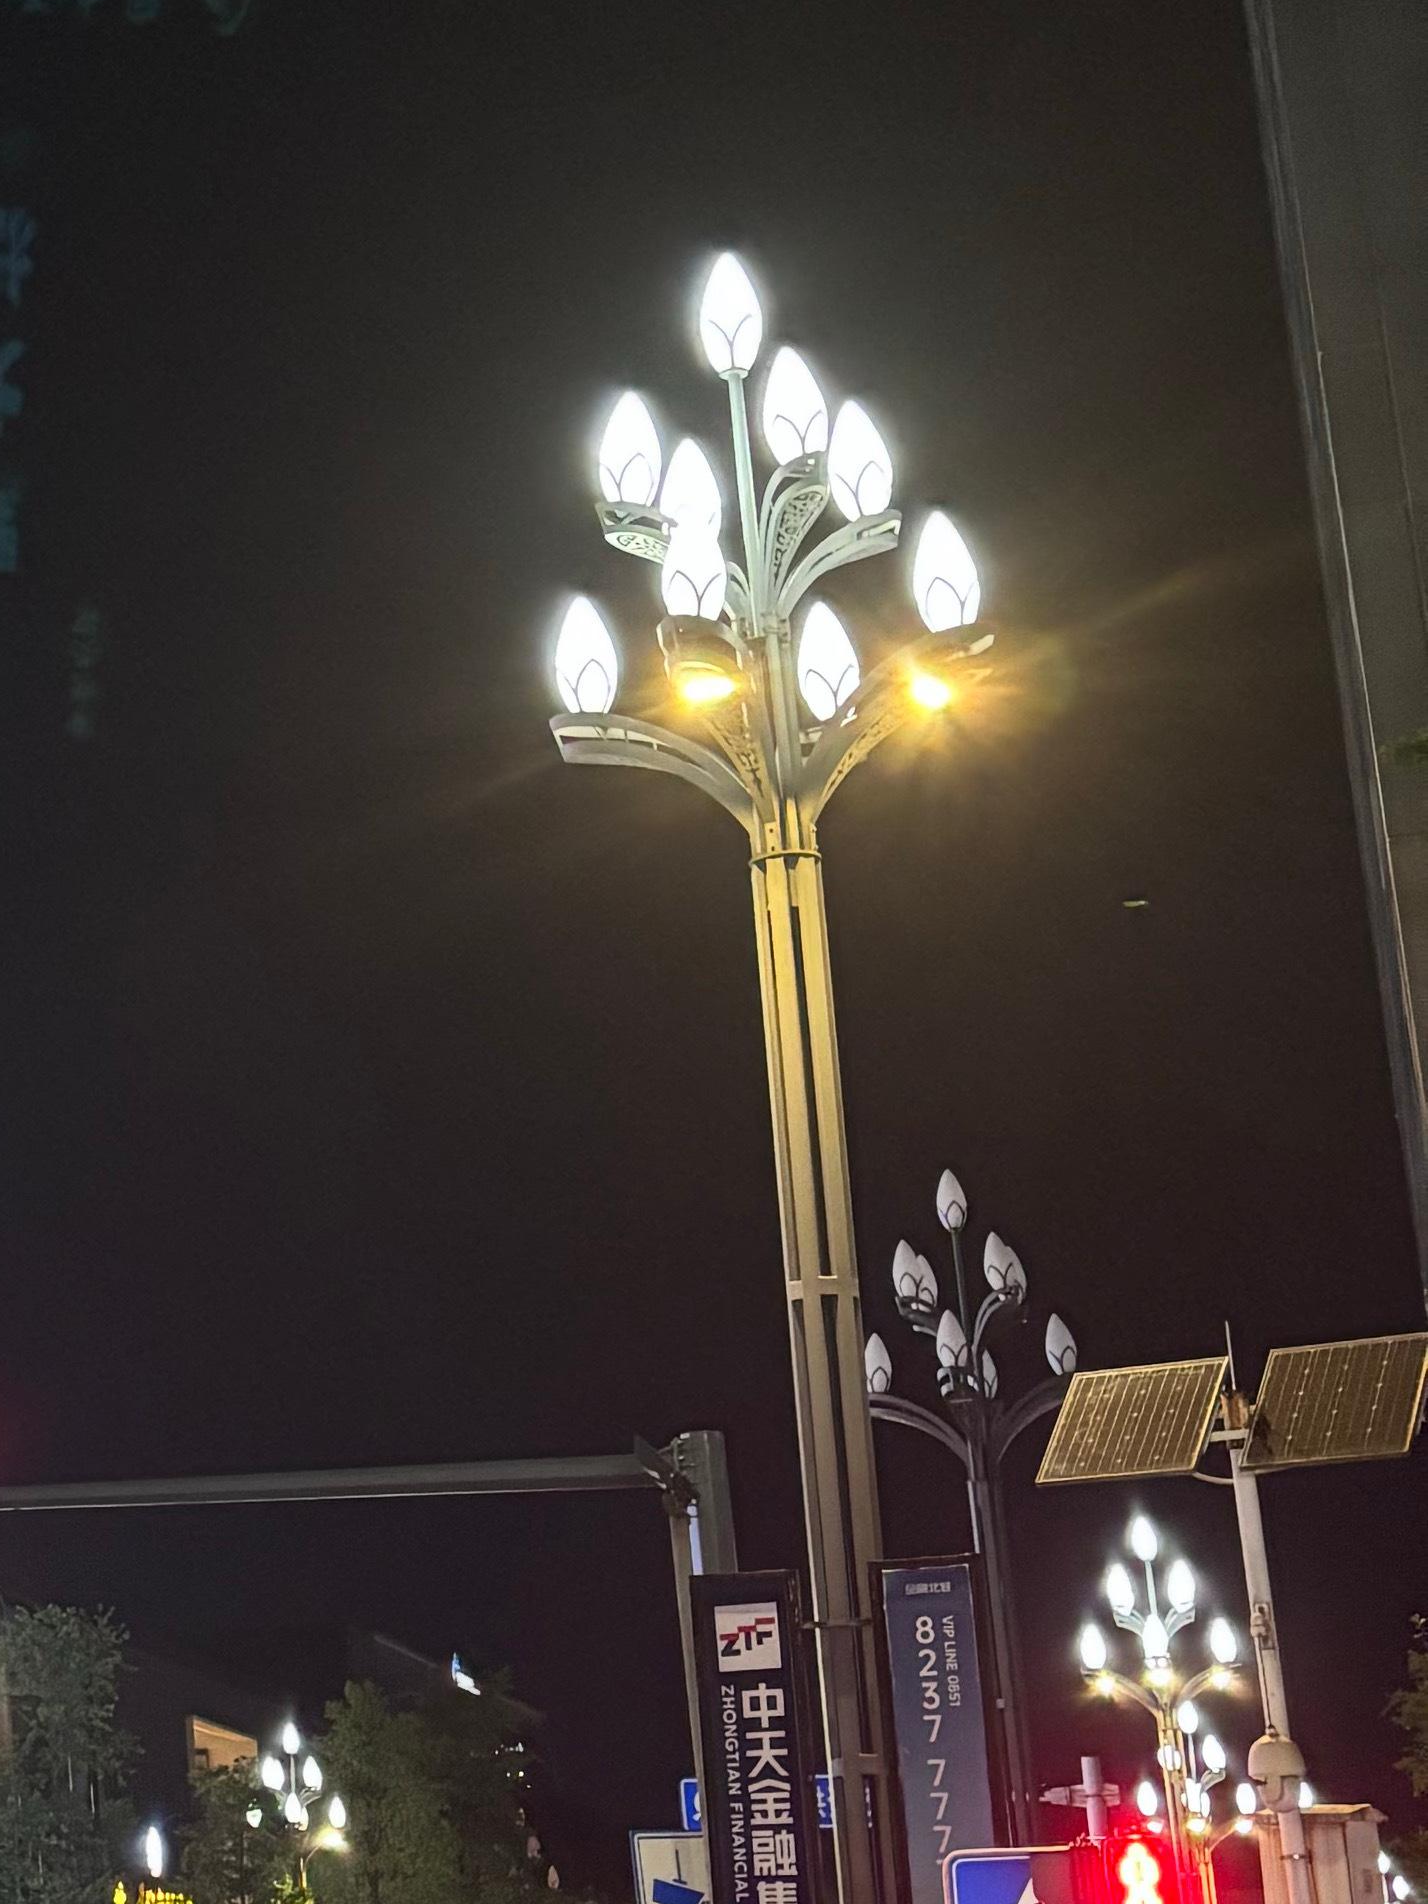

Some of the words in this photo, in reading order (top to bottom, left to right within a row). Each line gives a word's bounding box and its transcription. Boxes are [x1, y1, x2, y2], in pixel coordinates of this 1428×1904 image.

[719, 1616, 776, 1658] ZTF
[941, 1614, 955, 1639] VIP
[944, 1642, 959, 1671] LINE
[915, 1615, 943, 1743] 8237
[720, 1684, 743, 1796] ZHONGTIAN
[729, 1802, 748, 1903] FINANCIAL
[927, 1759, 952, 1864] 777
